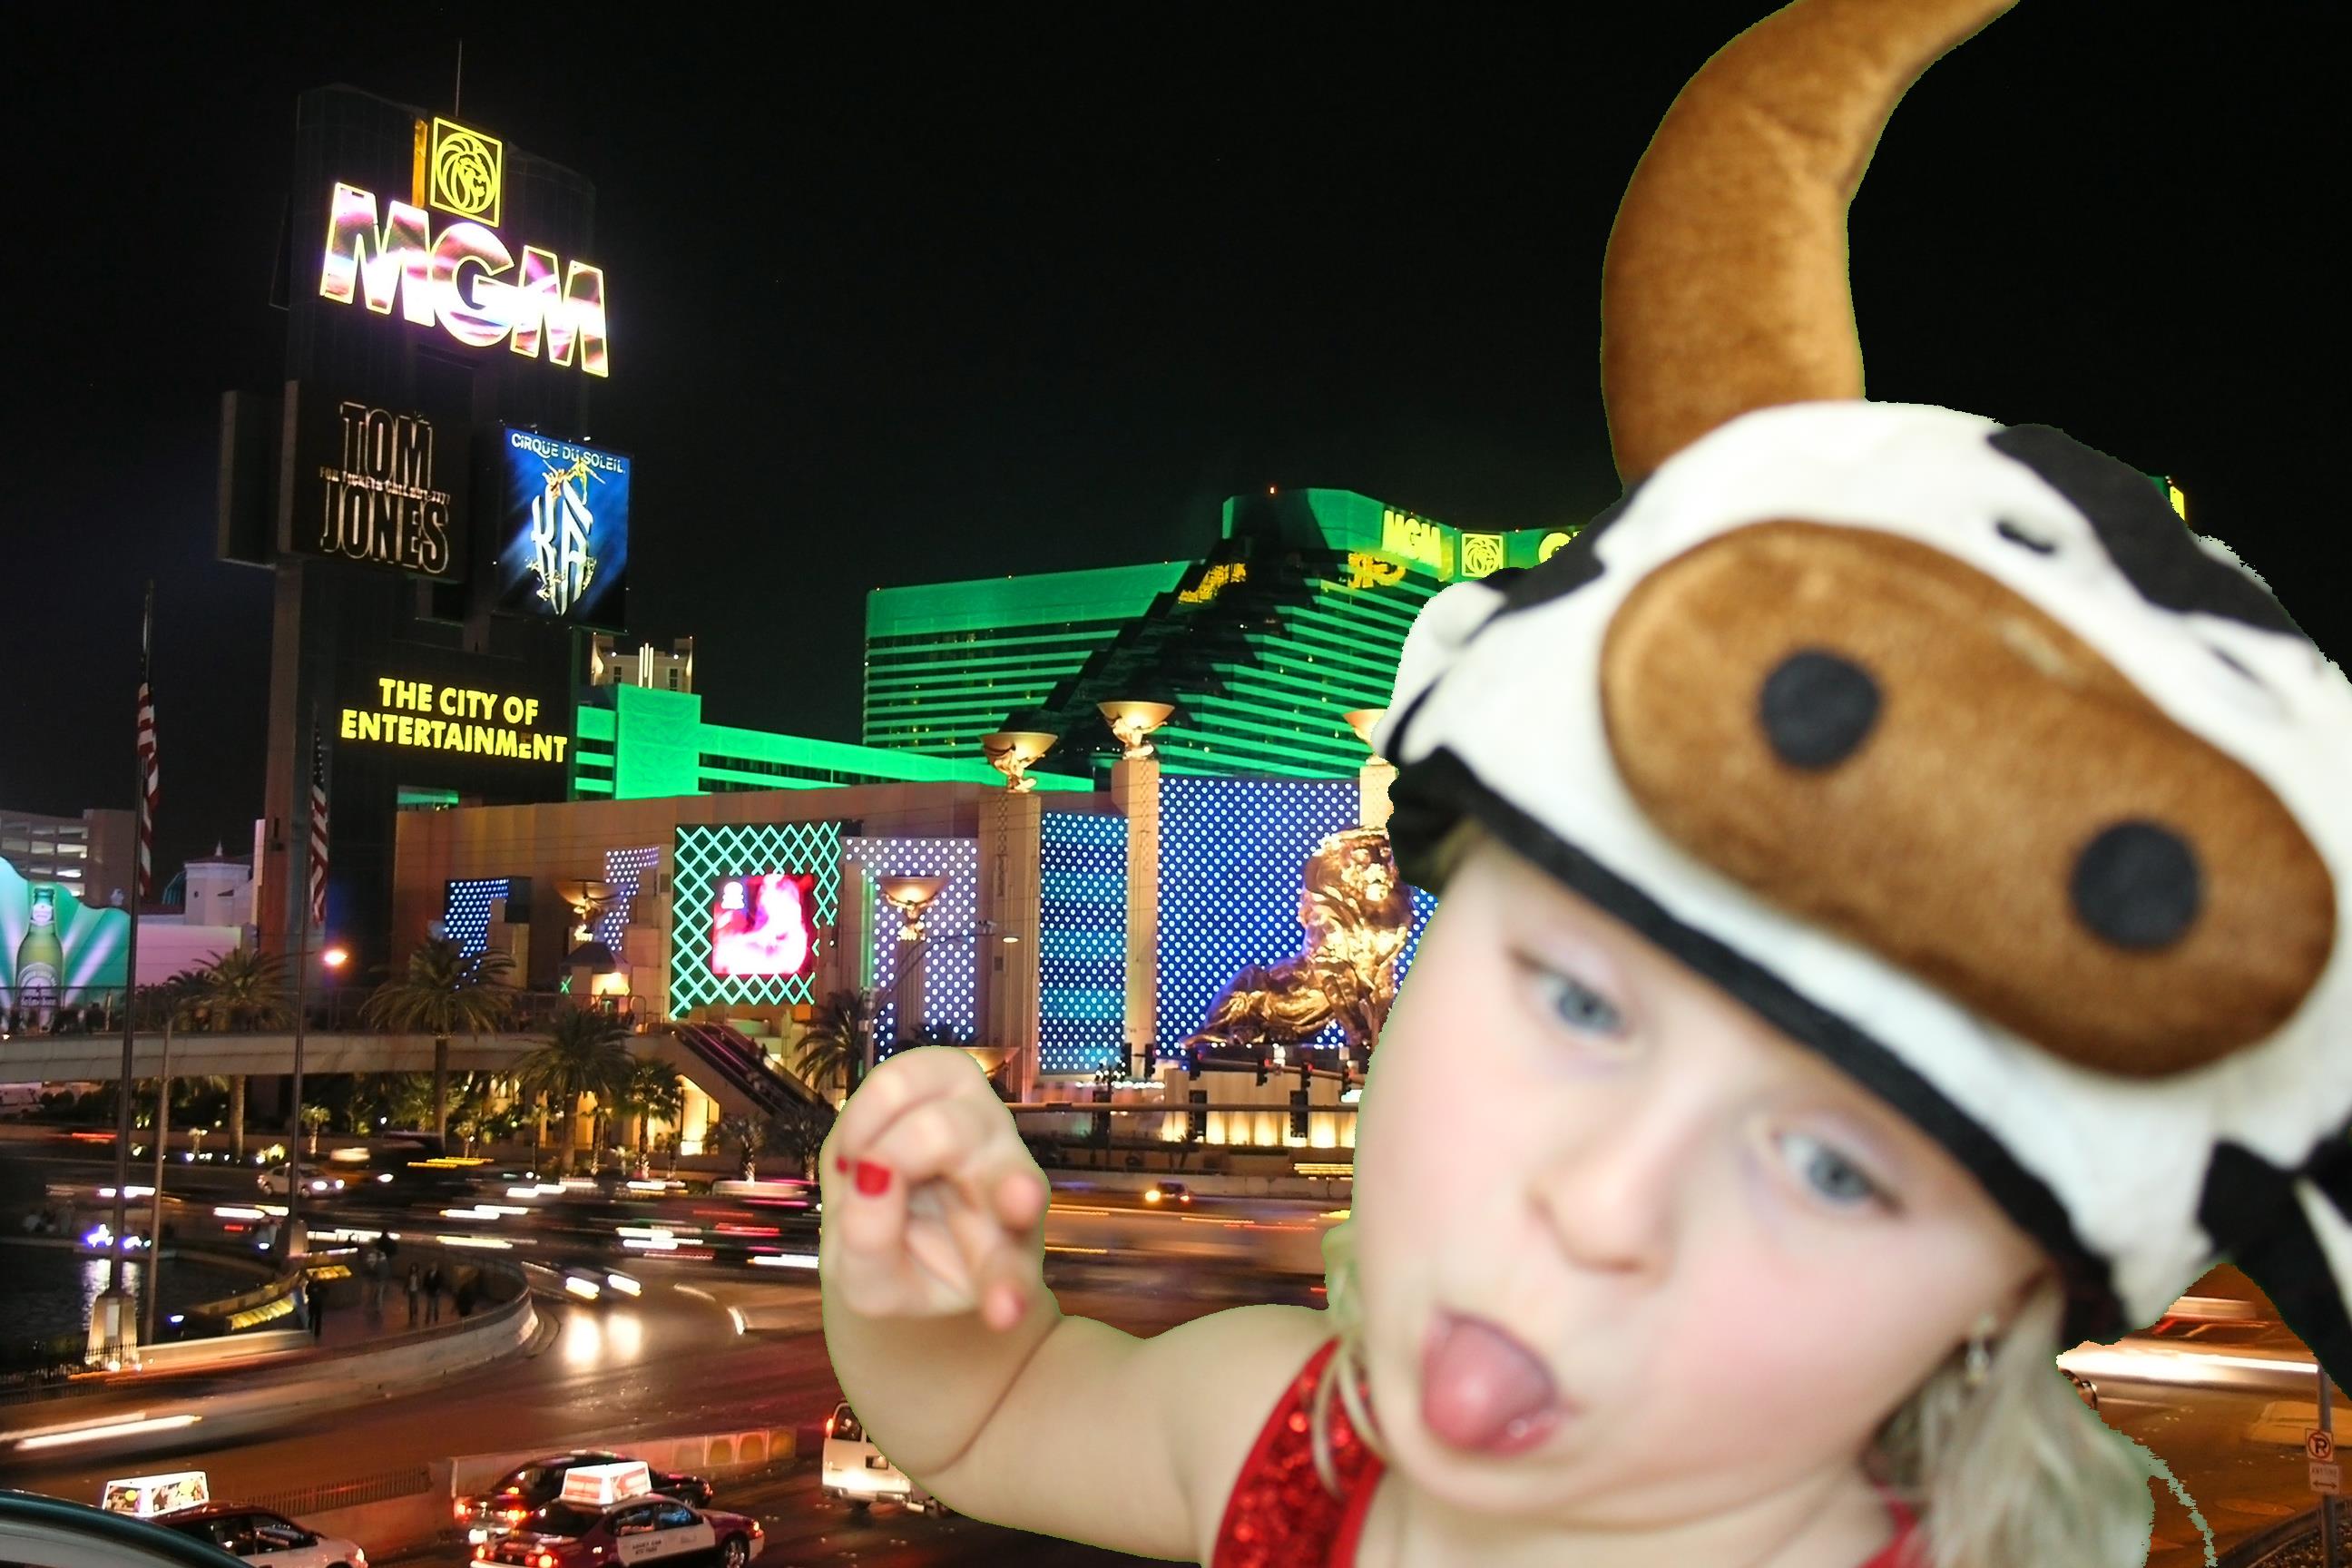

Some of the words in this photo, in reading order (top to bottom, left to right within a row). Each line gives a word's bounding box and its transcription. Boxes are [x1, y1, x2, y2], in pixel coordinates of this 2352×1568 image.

[320, 181, 609, 377] MGM
[339, 401, 433, 490] TOM
[511, 433, 559, 459] CIRQUE
[563, 446, 580, 462] DU
[582, 451, 624, 474] SOLEIL
[320, 481, 449, 573] JONES
[1381, 509, 1442, 569] MGM
[378, 677, 434, 712] THE
[439, 687, 498, 720] CITY
[503, 695, 539, 726] OF
[340, 709, 568, 763] ENTERTAINMENT
